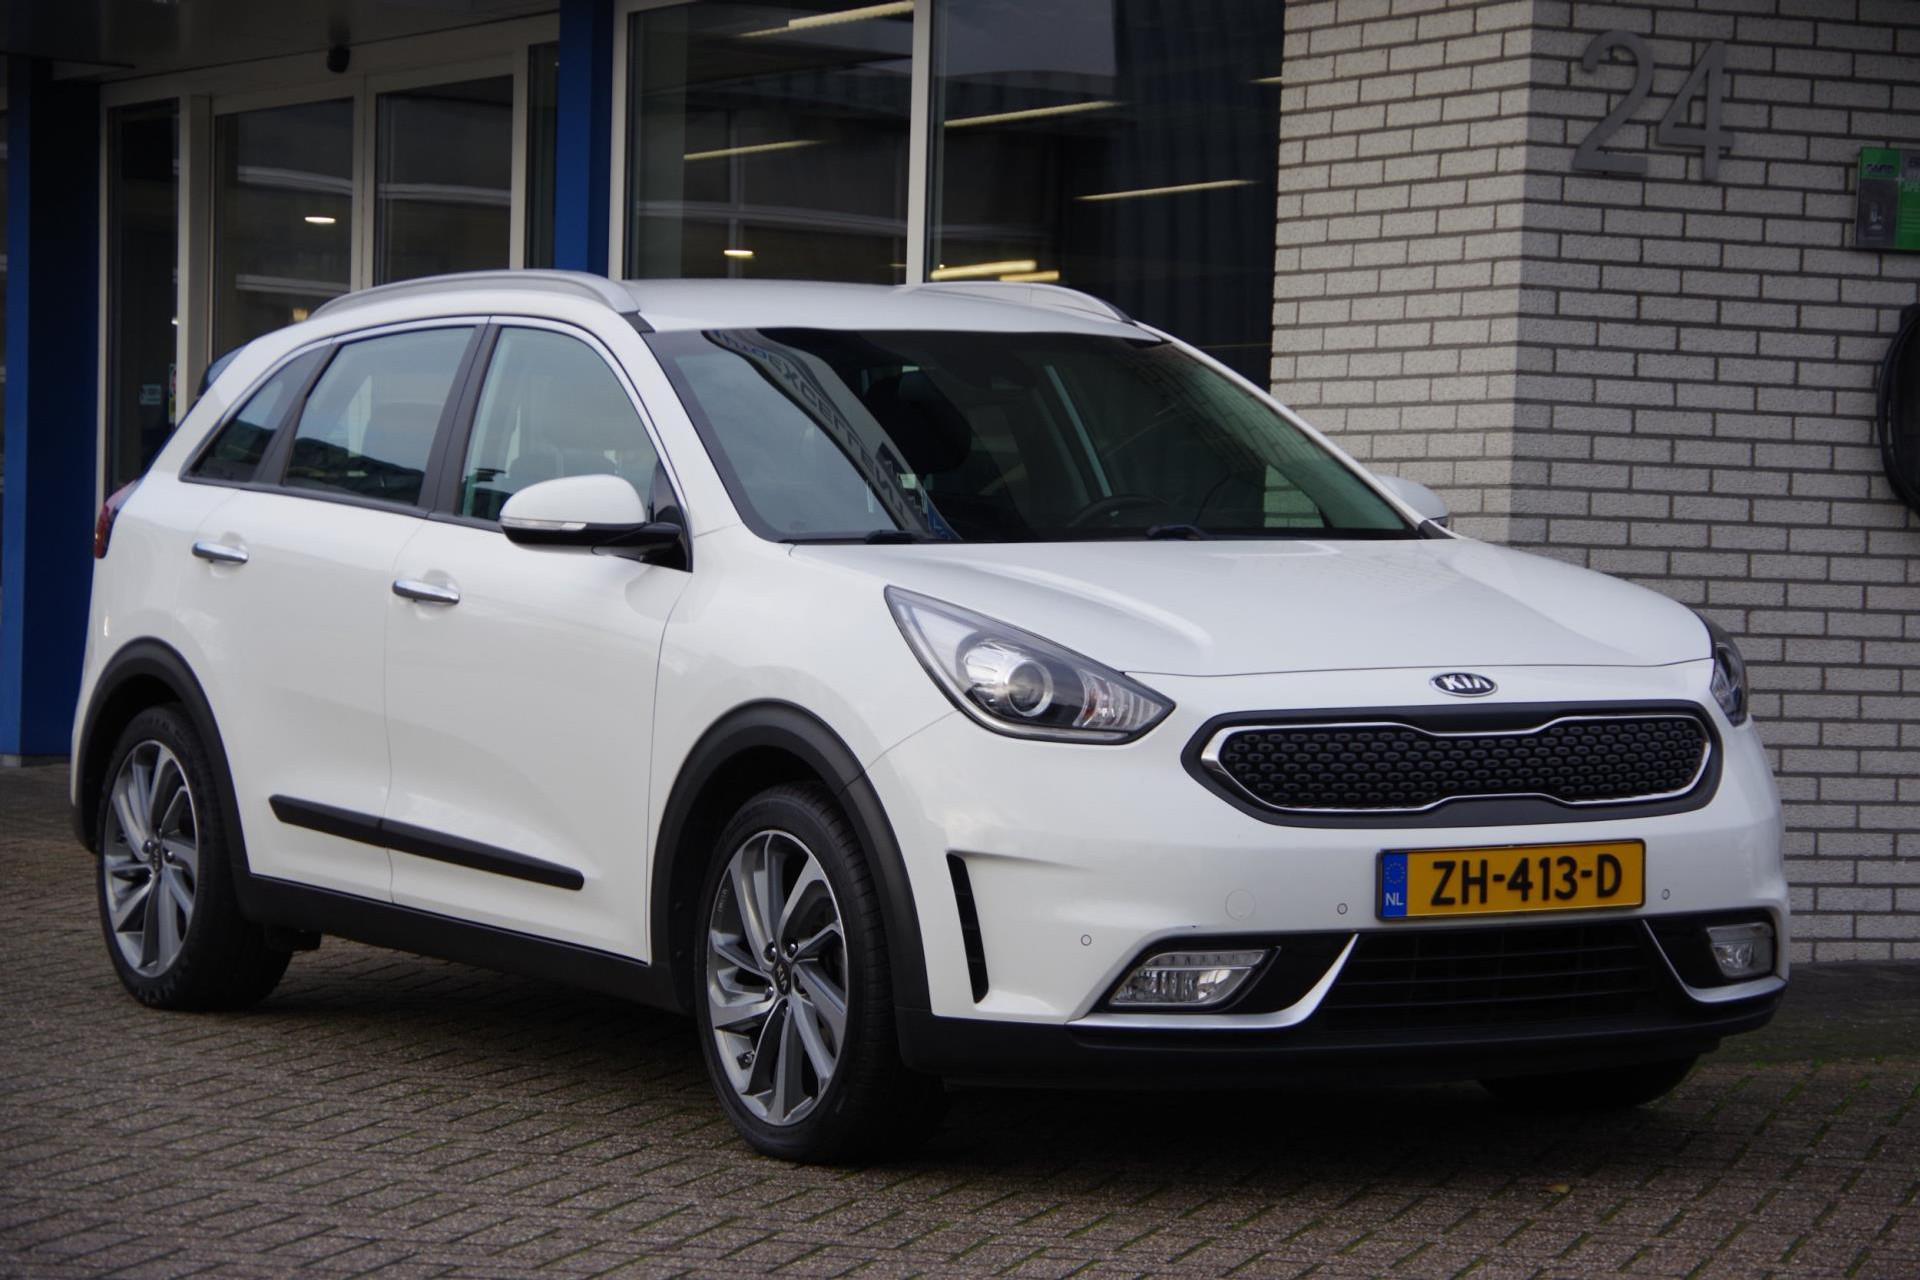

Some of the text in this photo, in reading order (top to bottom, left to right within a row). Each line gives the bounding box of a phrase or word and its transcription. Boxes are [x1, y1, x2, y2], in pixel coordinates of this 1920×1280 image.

[1572, 30, 1735, 181] 24
[1440, 674, 1492, 691] KIA
[1430, 853, 1622, 907] ZH-413-D
[1385, 892, 1404, 906] NL
[776, 963, 788, 991] KIA
